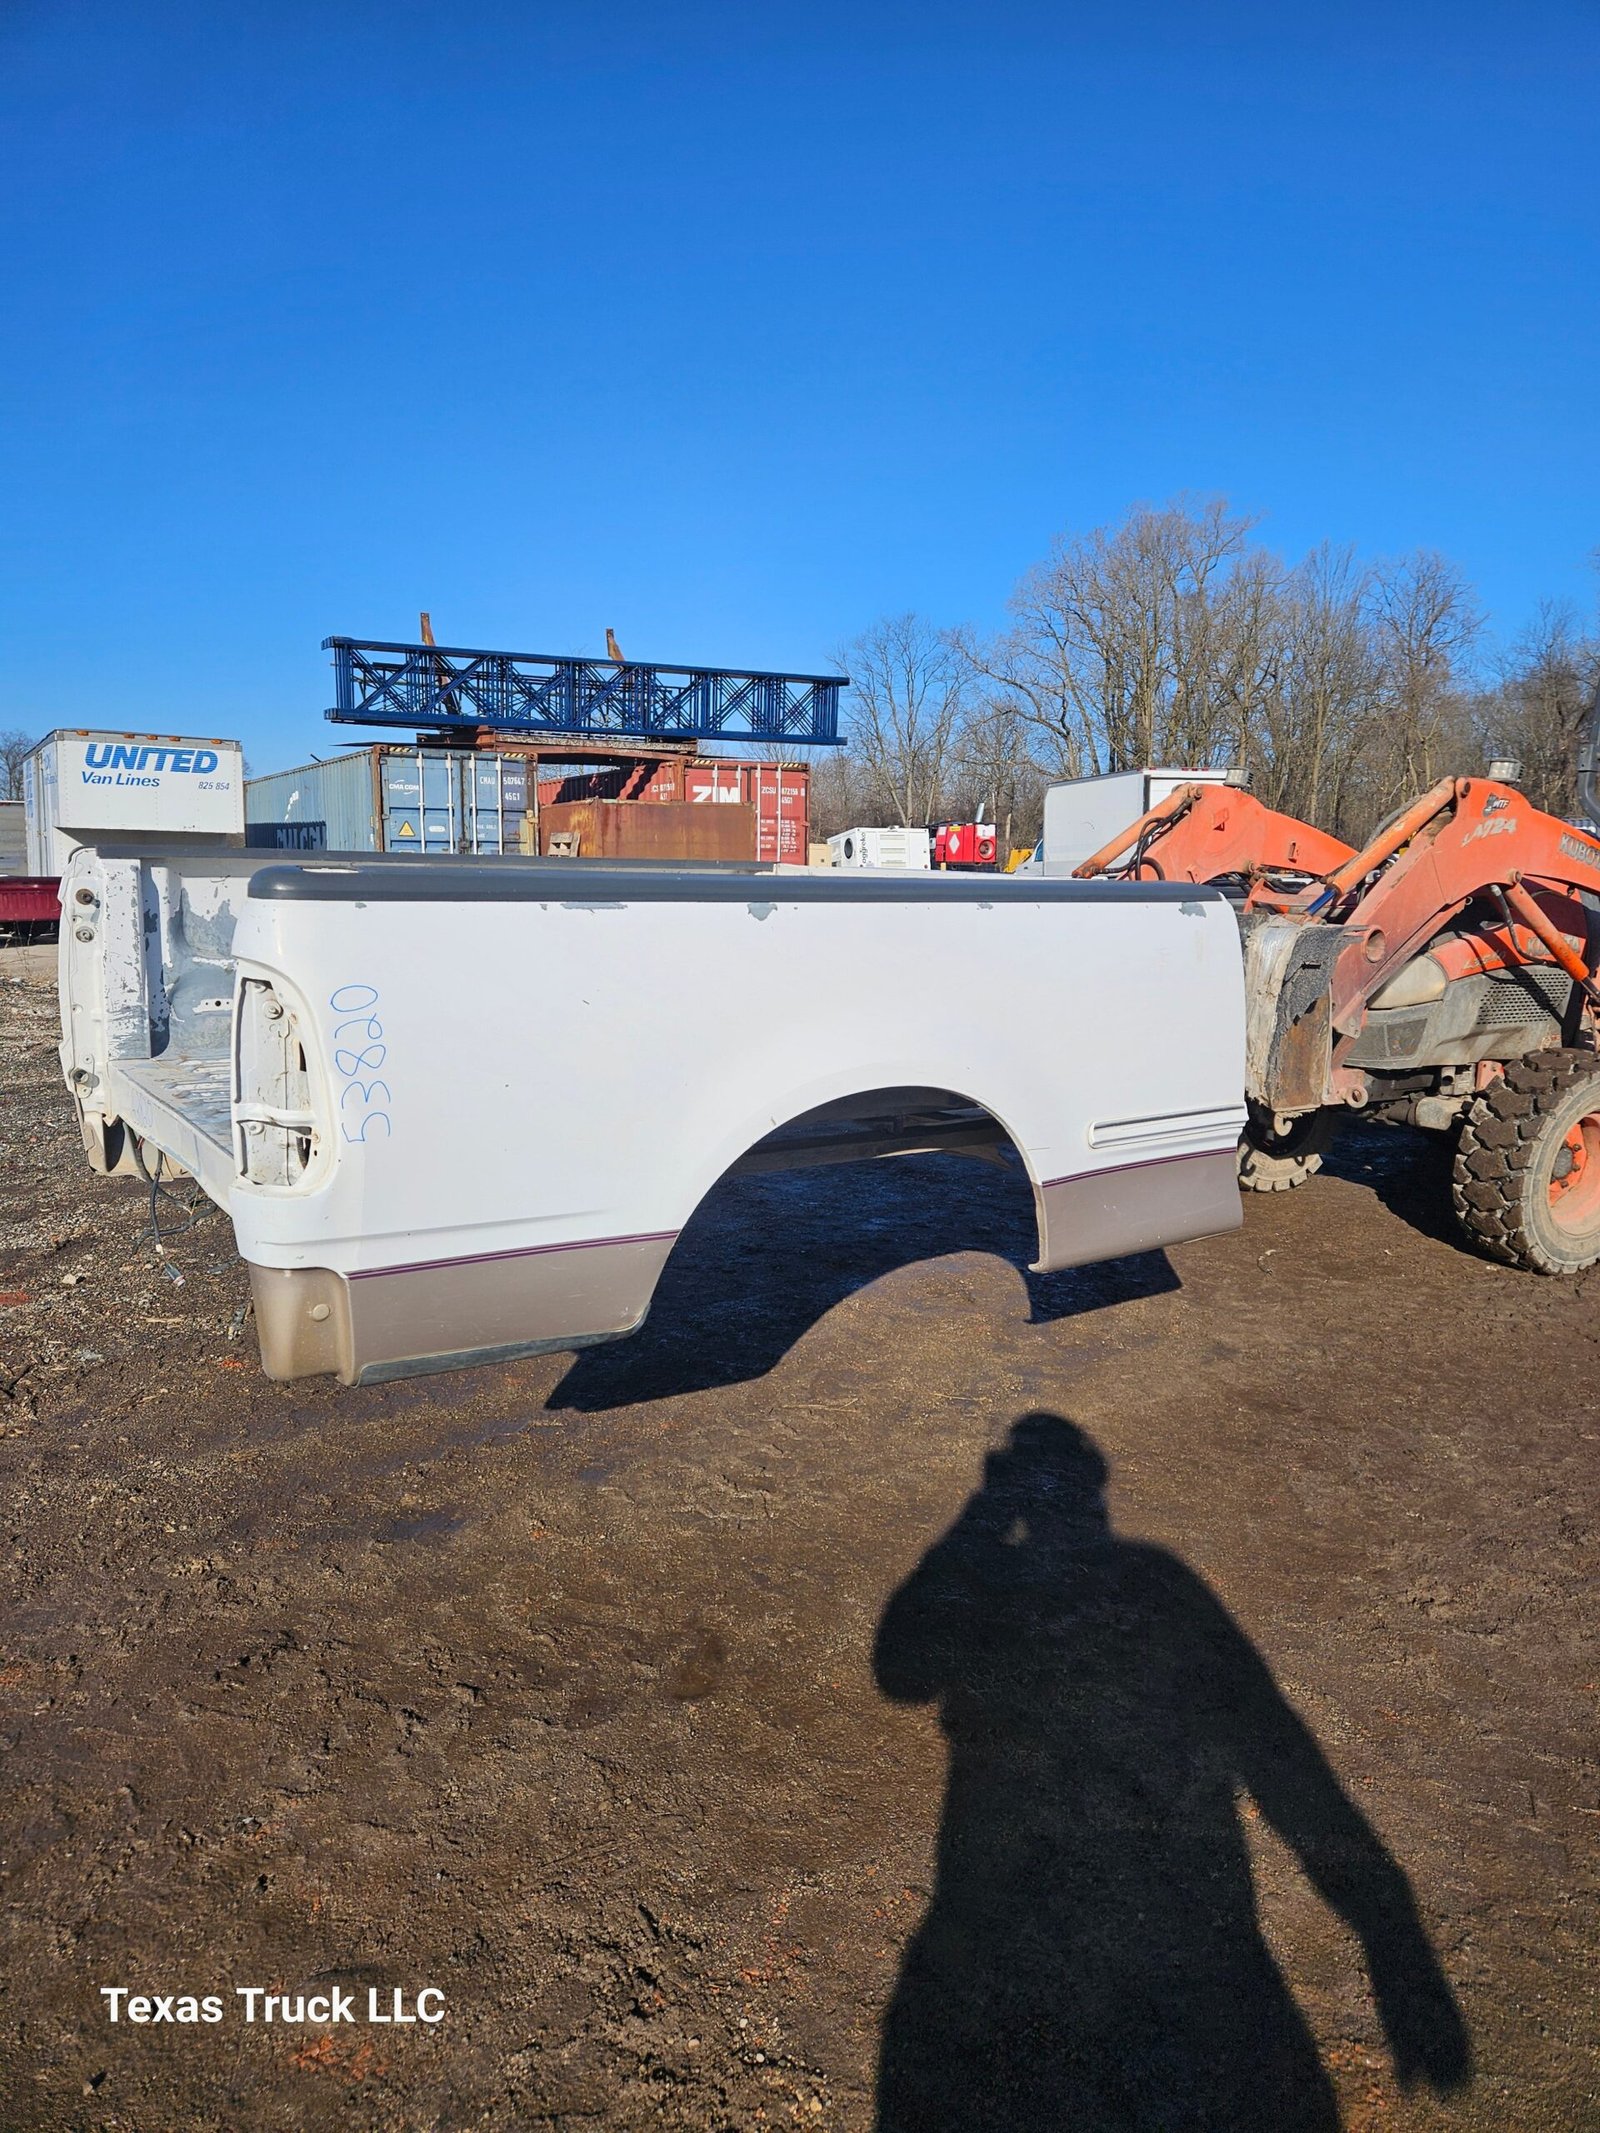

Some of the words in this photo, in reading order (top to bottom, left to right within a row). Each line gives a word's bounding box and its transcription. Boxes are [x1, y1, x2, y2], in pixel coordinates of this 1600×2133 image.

[85, 743, 218, 774] UNITED
[82, 771, 112, 785] Van
[116, 773, 160, 787] Lines
[198, 781, 213, 790] 825
[215, 782, 230, 791] 854
[692, 785, 741, 803] ZIM
[330, 984, 391, 1143] 53820
